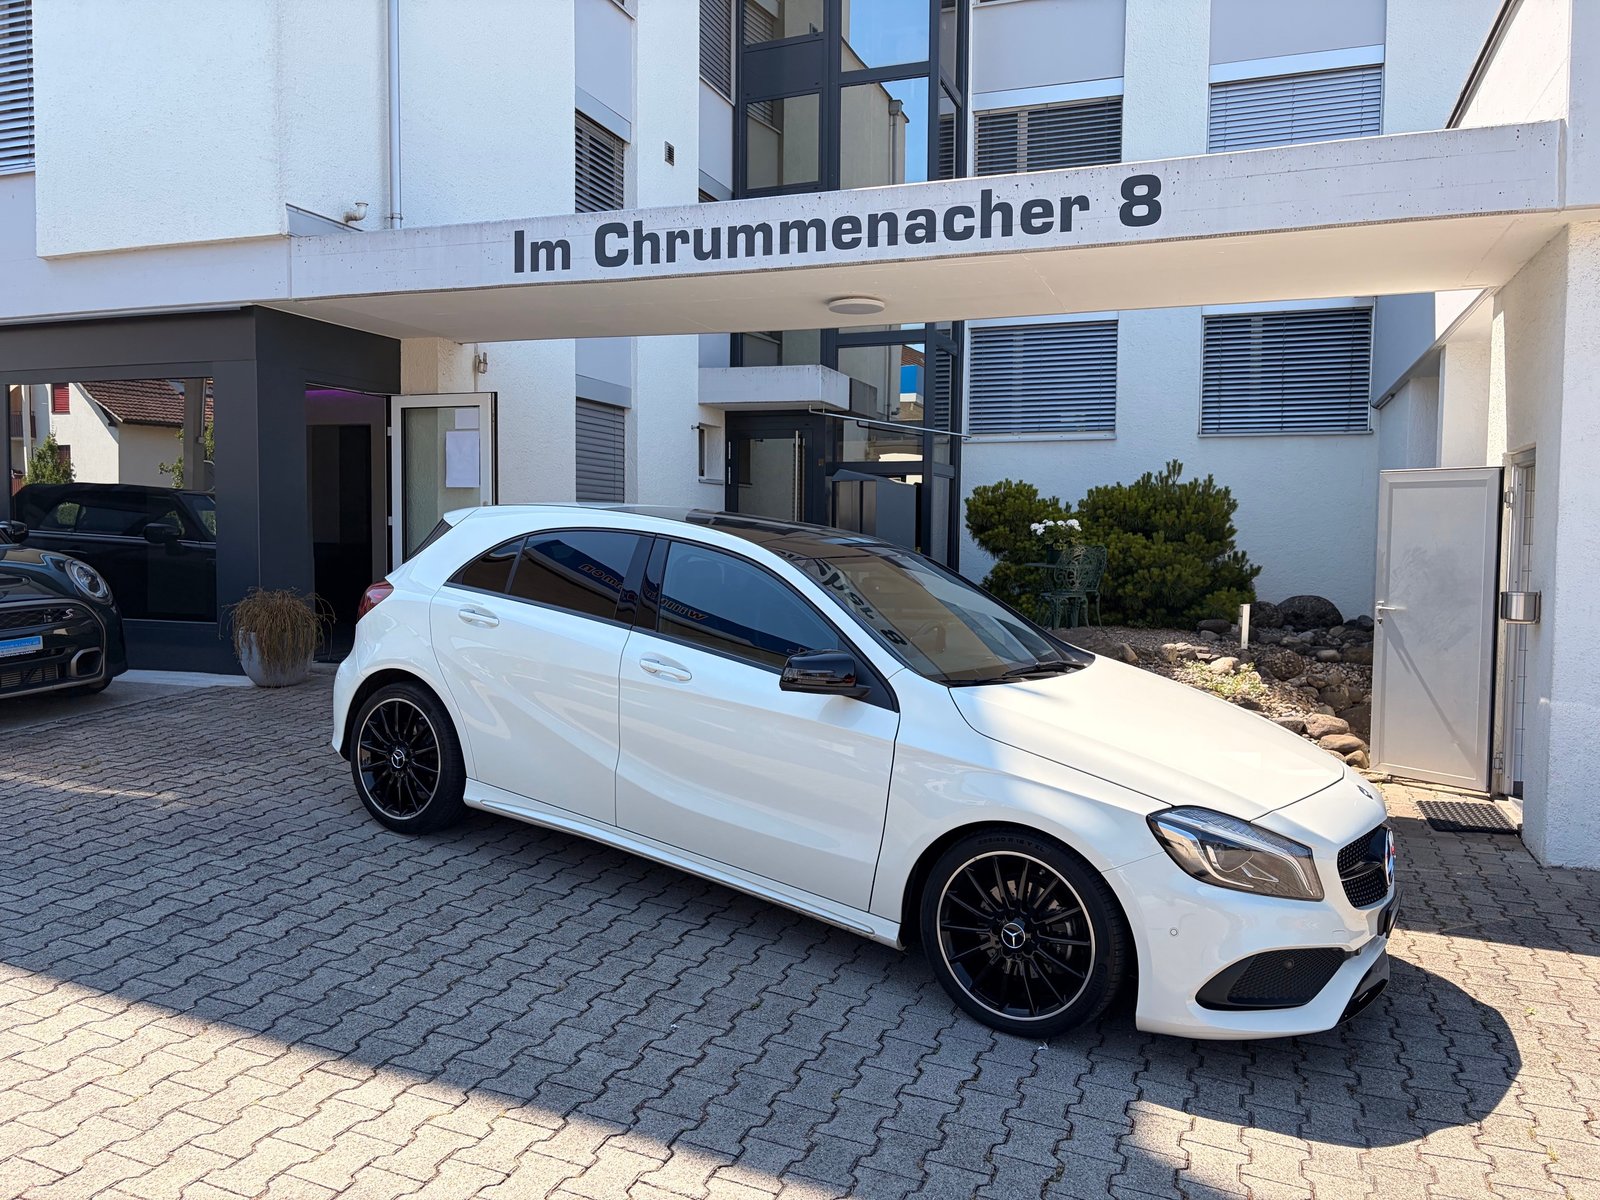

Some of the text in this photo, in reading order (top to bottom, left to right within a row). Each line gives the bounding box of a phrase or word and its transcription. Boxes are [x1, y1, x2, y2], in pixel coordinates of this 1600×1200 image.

[514, 174, 1162, 273] Im Chrummenacher 8
